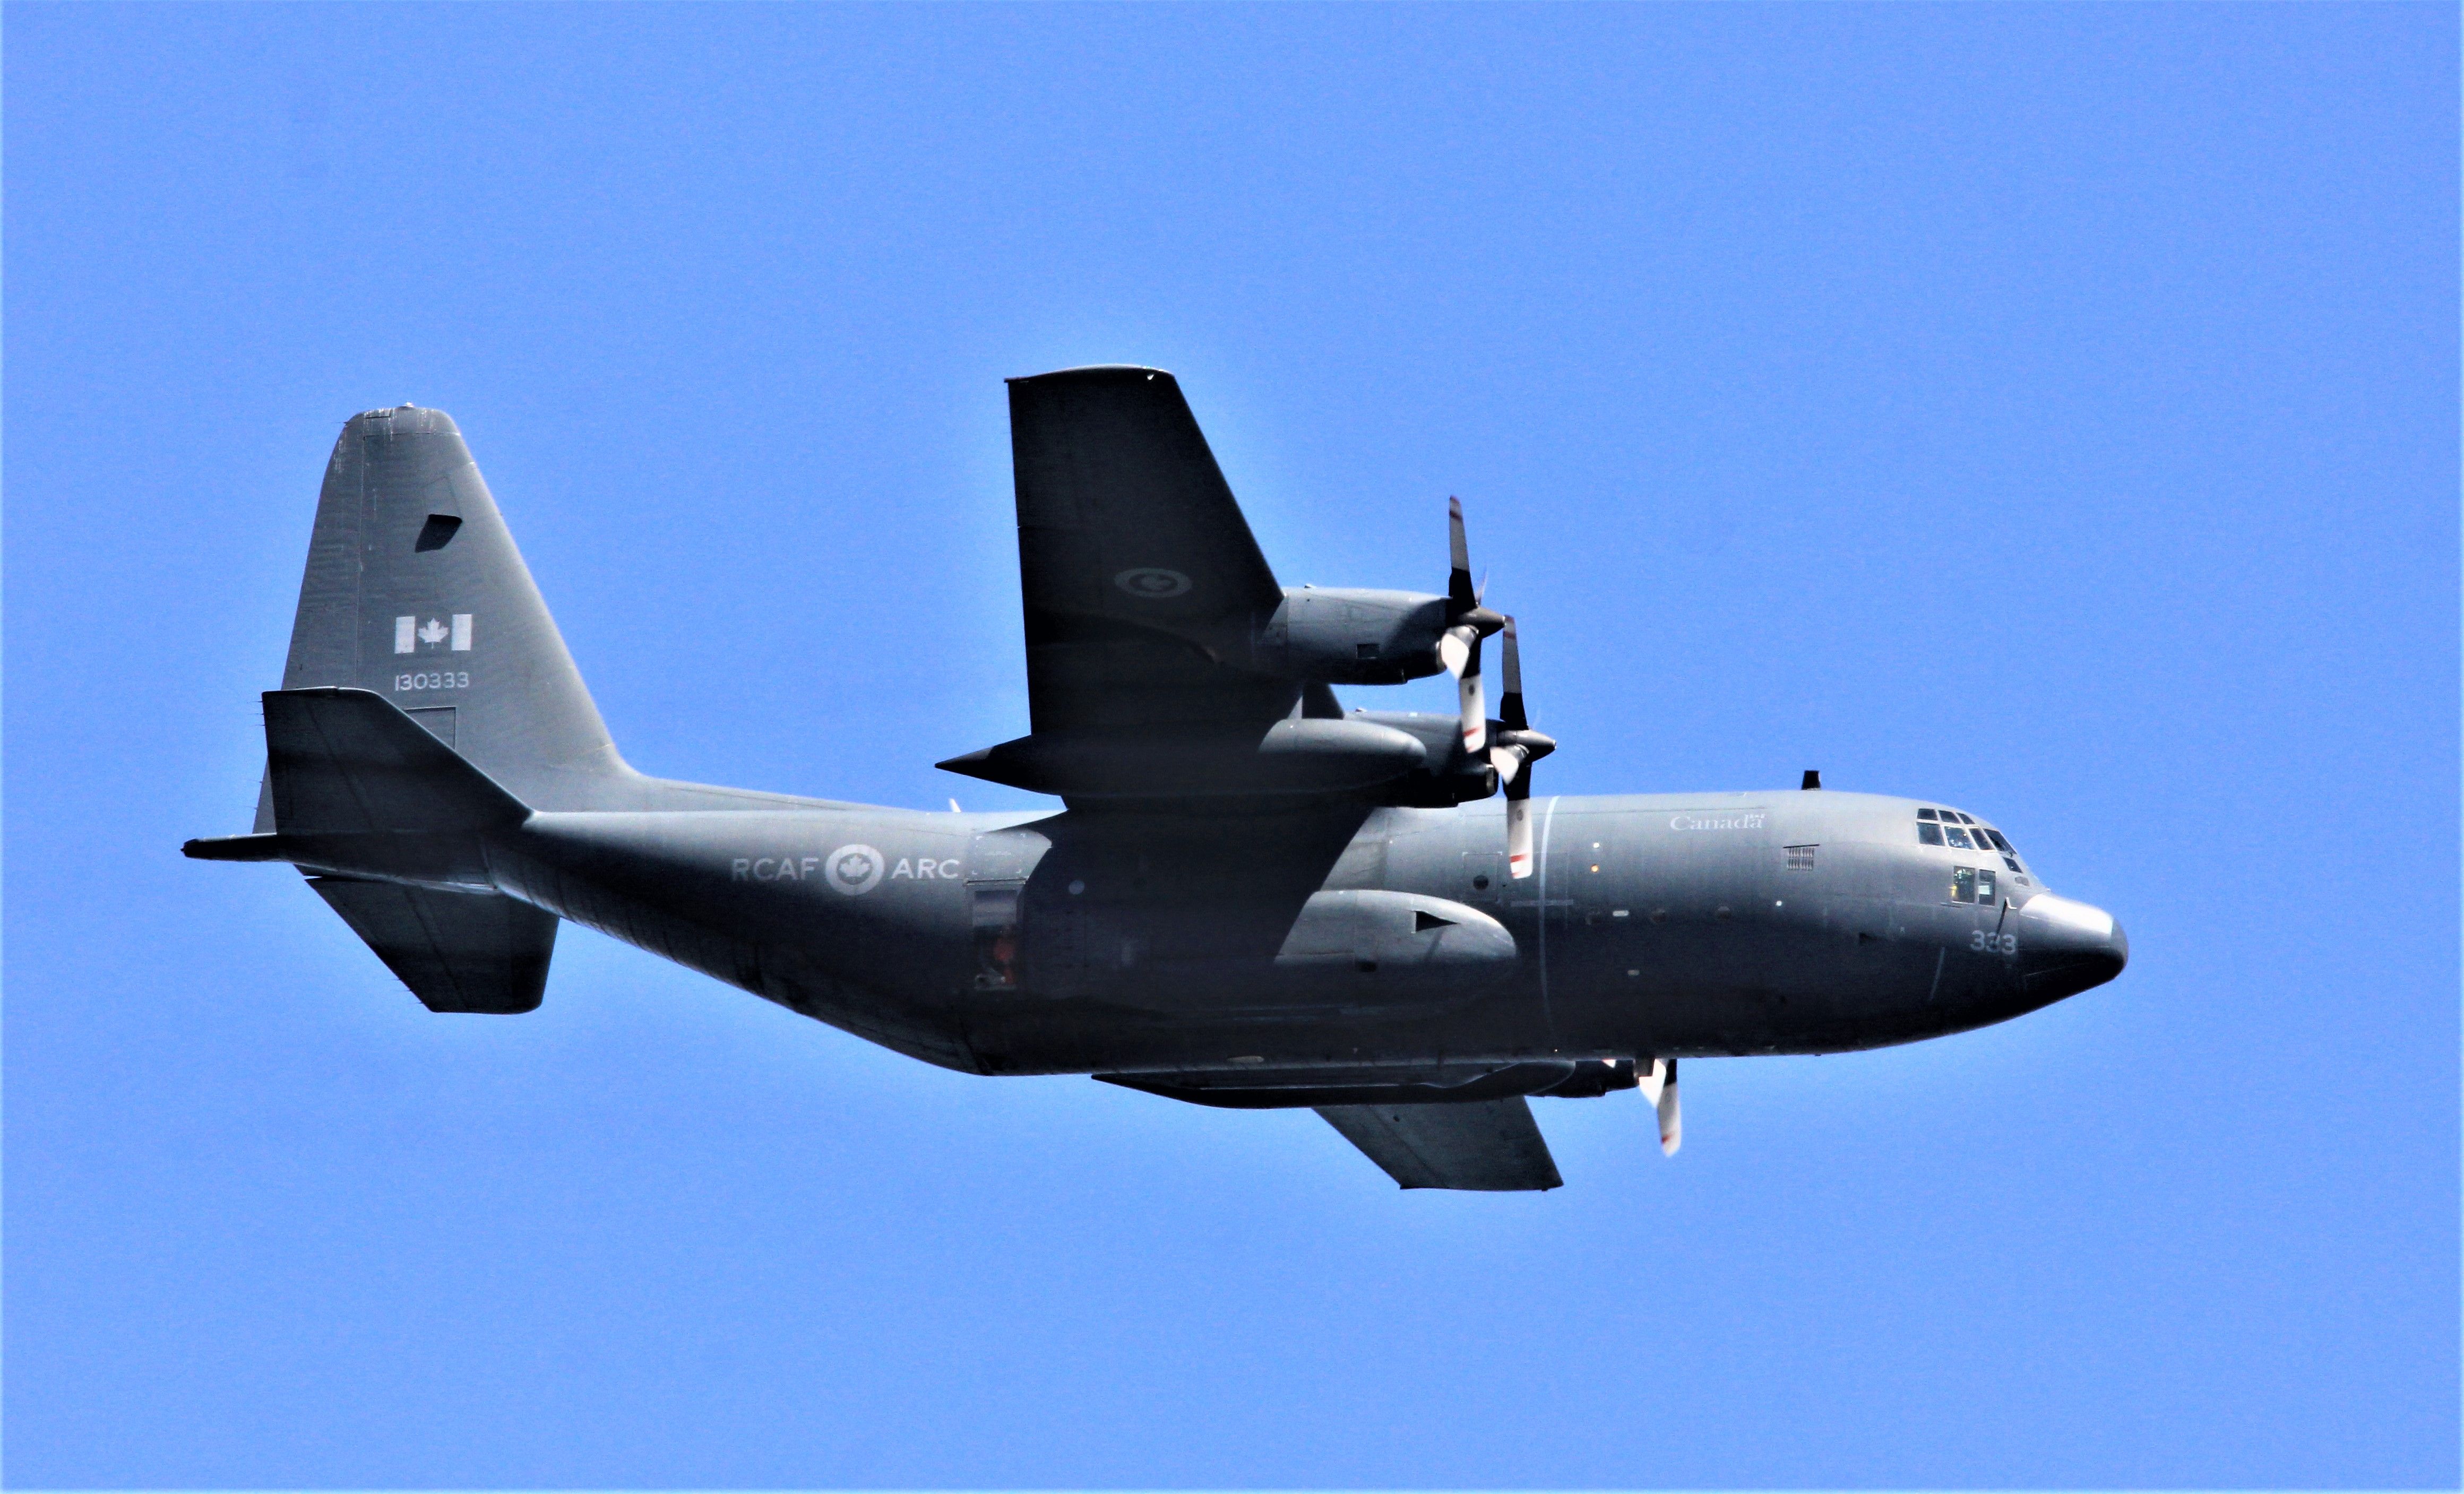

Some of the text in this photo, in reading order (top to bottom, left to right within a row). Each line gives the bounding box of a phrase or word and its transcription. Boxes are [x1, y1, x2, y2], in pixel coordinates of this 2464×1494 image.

[395, 671, 469, 691] 130333
[1670, 814, 1765, 831] Canada
[731, 857, 960, 881] RCAF ARC
[1970, 930, 2017, 955] 333
